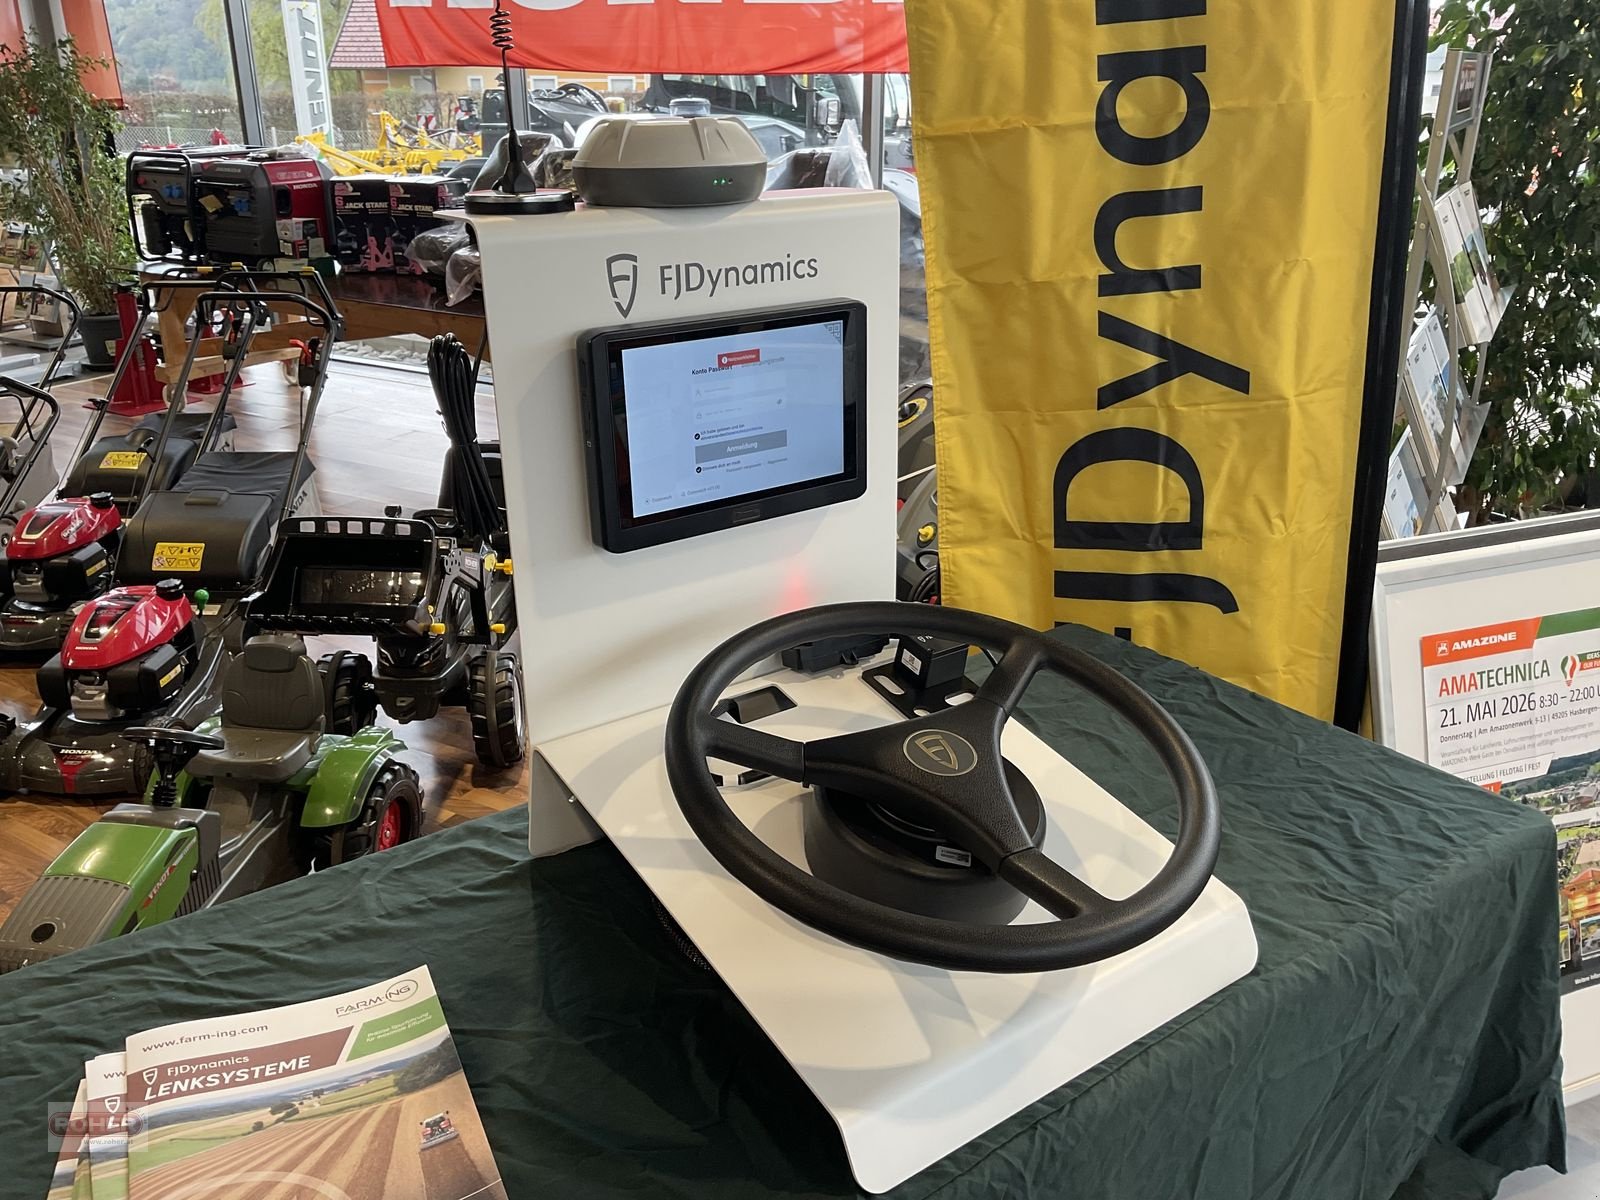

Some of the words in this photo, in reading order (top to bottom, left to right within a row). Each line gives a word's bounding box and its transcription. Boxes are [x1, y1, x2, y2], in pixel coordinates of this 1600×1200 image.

[414, 204, 433, 212] STAND
[659, 253, 818, 301] FJDynamics
[691, 367, 708, 375] Konto
[726, 441, 758, 453] Anmeldung
[1452, 632, 1517, 651] AMAZONE
[1438, 659, 1551, 697] AMATECHNICA
[1440, 707, 1462, 728] 21.
[1466, 699, 1497, 723] MAI
[1501, 692, 1537, 716] 2026
[1539, 692, 1559, 709] 8:30
[1569, 686, 1595, 702] 22:00
[1440, 728, 1473, 744] Donnerstag
[1478, 726, 1489, 736] Am
[1489, 718, 1534, 733] Amazonenwerk
[1499, 766, 1523, 777] FELDTAG
[1528, 762, 1541, 771] FEST
[142, 1023, 269, 1053] www.farm-ing.com
[167, 1056, 250, 1076] FJDynamics
[144, 1055, 312, 1101] LENKSYSTEME
